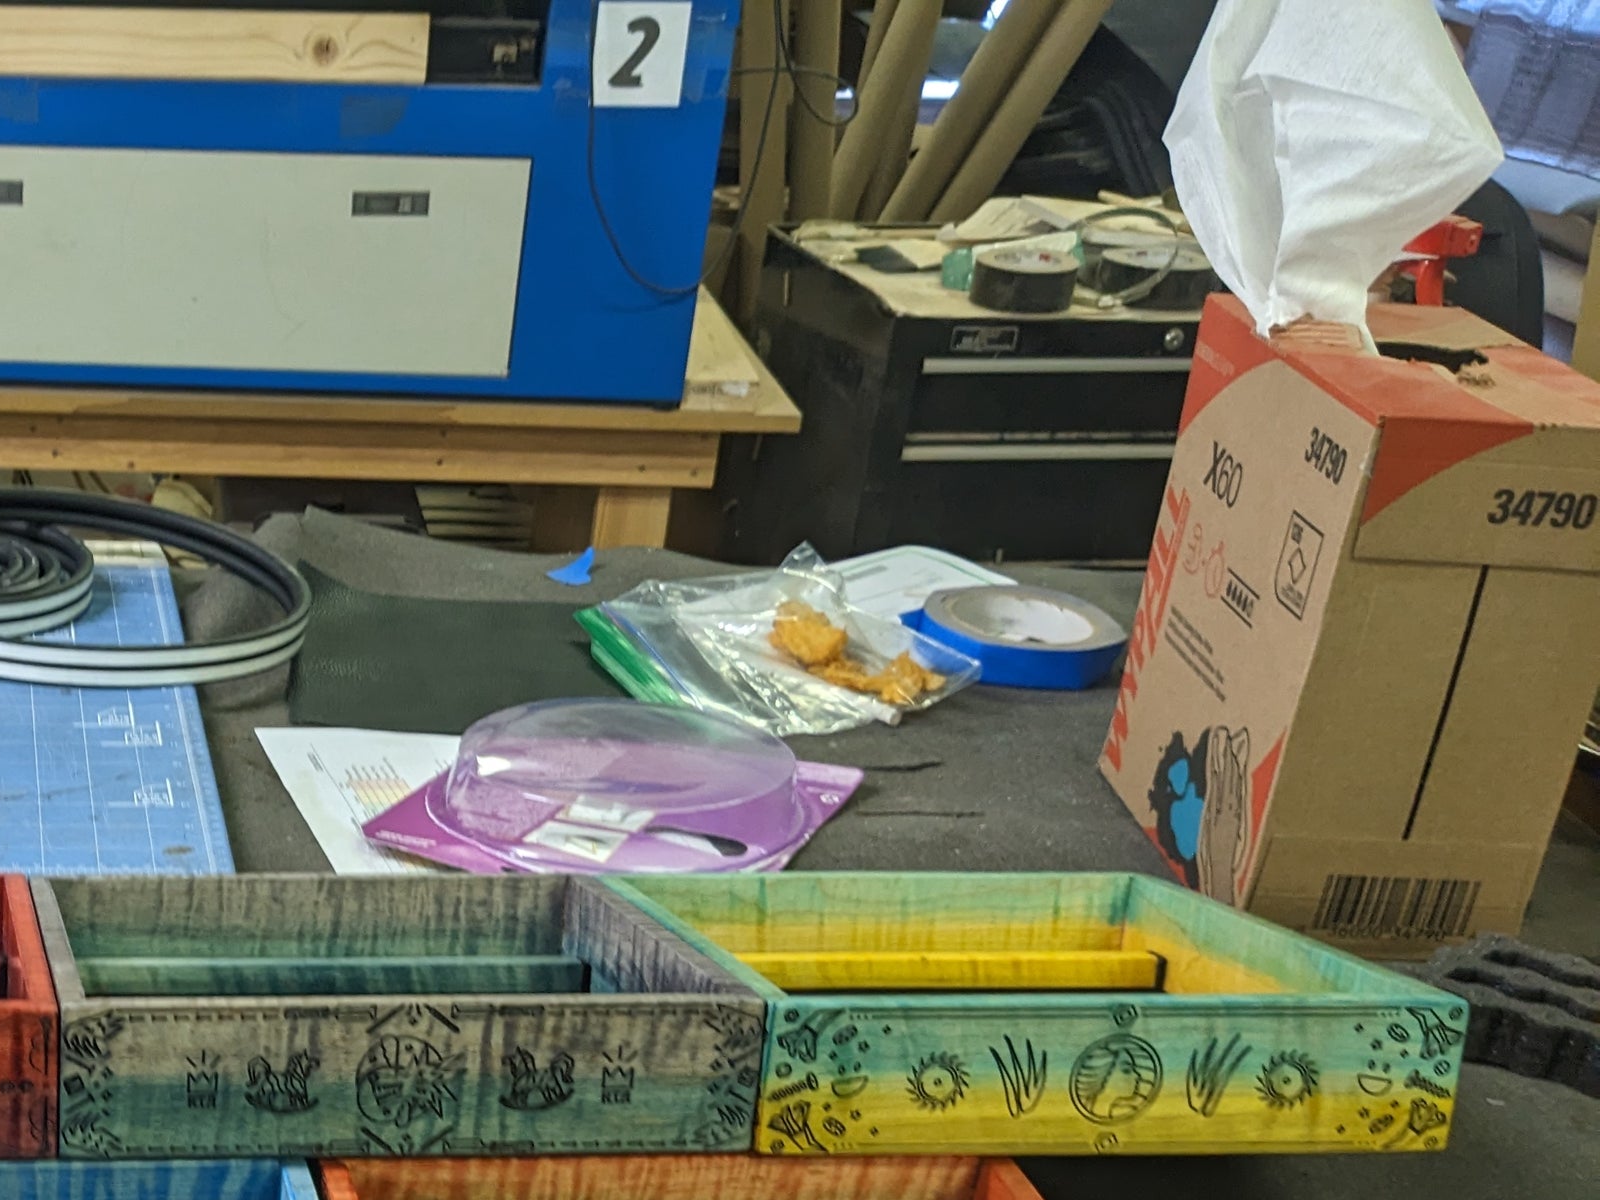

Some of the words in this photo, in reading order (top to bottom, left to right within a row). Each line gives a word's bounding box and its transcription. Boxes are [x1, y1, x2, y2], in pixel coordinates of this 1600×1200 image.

[608, 15, 660, 88] 2
[1203, 440, 1243, 509] X60
[1304, 426, 1348, 485] 34790
[1486, 488, 1598, 530] 34790
